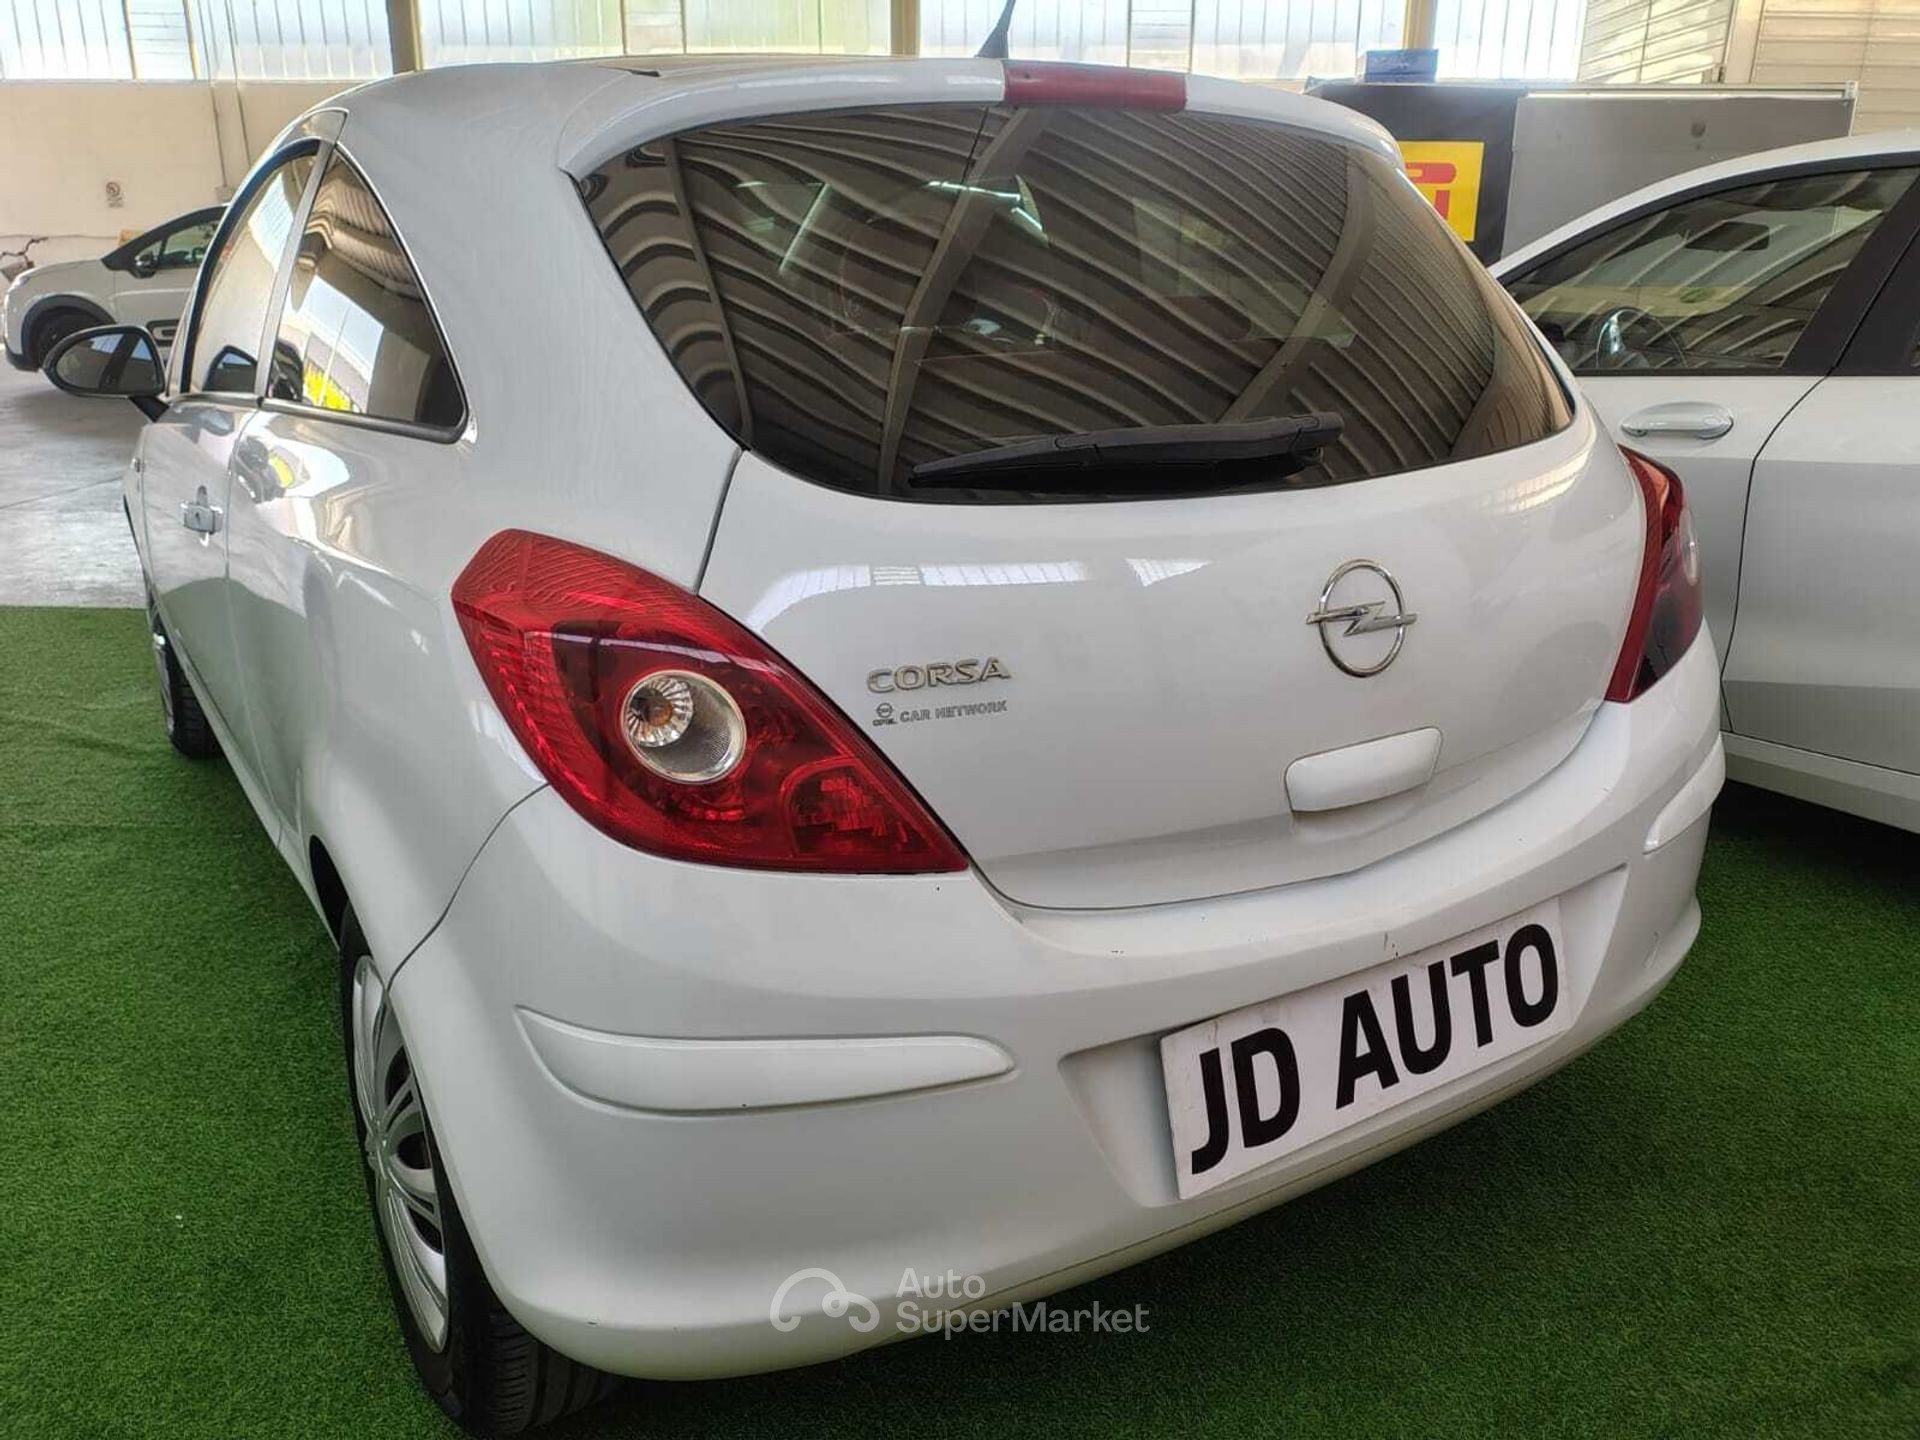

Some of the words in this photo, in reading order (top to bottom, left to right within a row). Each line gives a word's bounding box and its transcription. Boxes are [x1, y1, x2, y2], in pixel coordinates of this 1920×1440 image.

[867, 656, 1011, 694] CORSA
[900, 709, 931, 723] CAR
[935, 700, 1008, 719] NETWORK
[1191, 1027, 1300, 1175] JD
[1336, 923, 1559, 1110] AUTO
